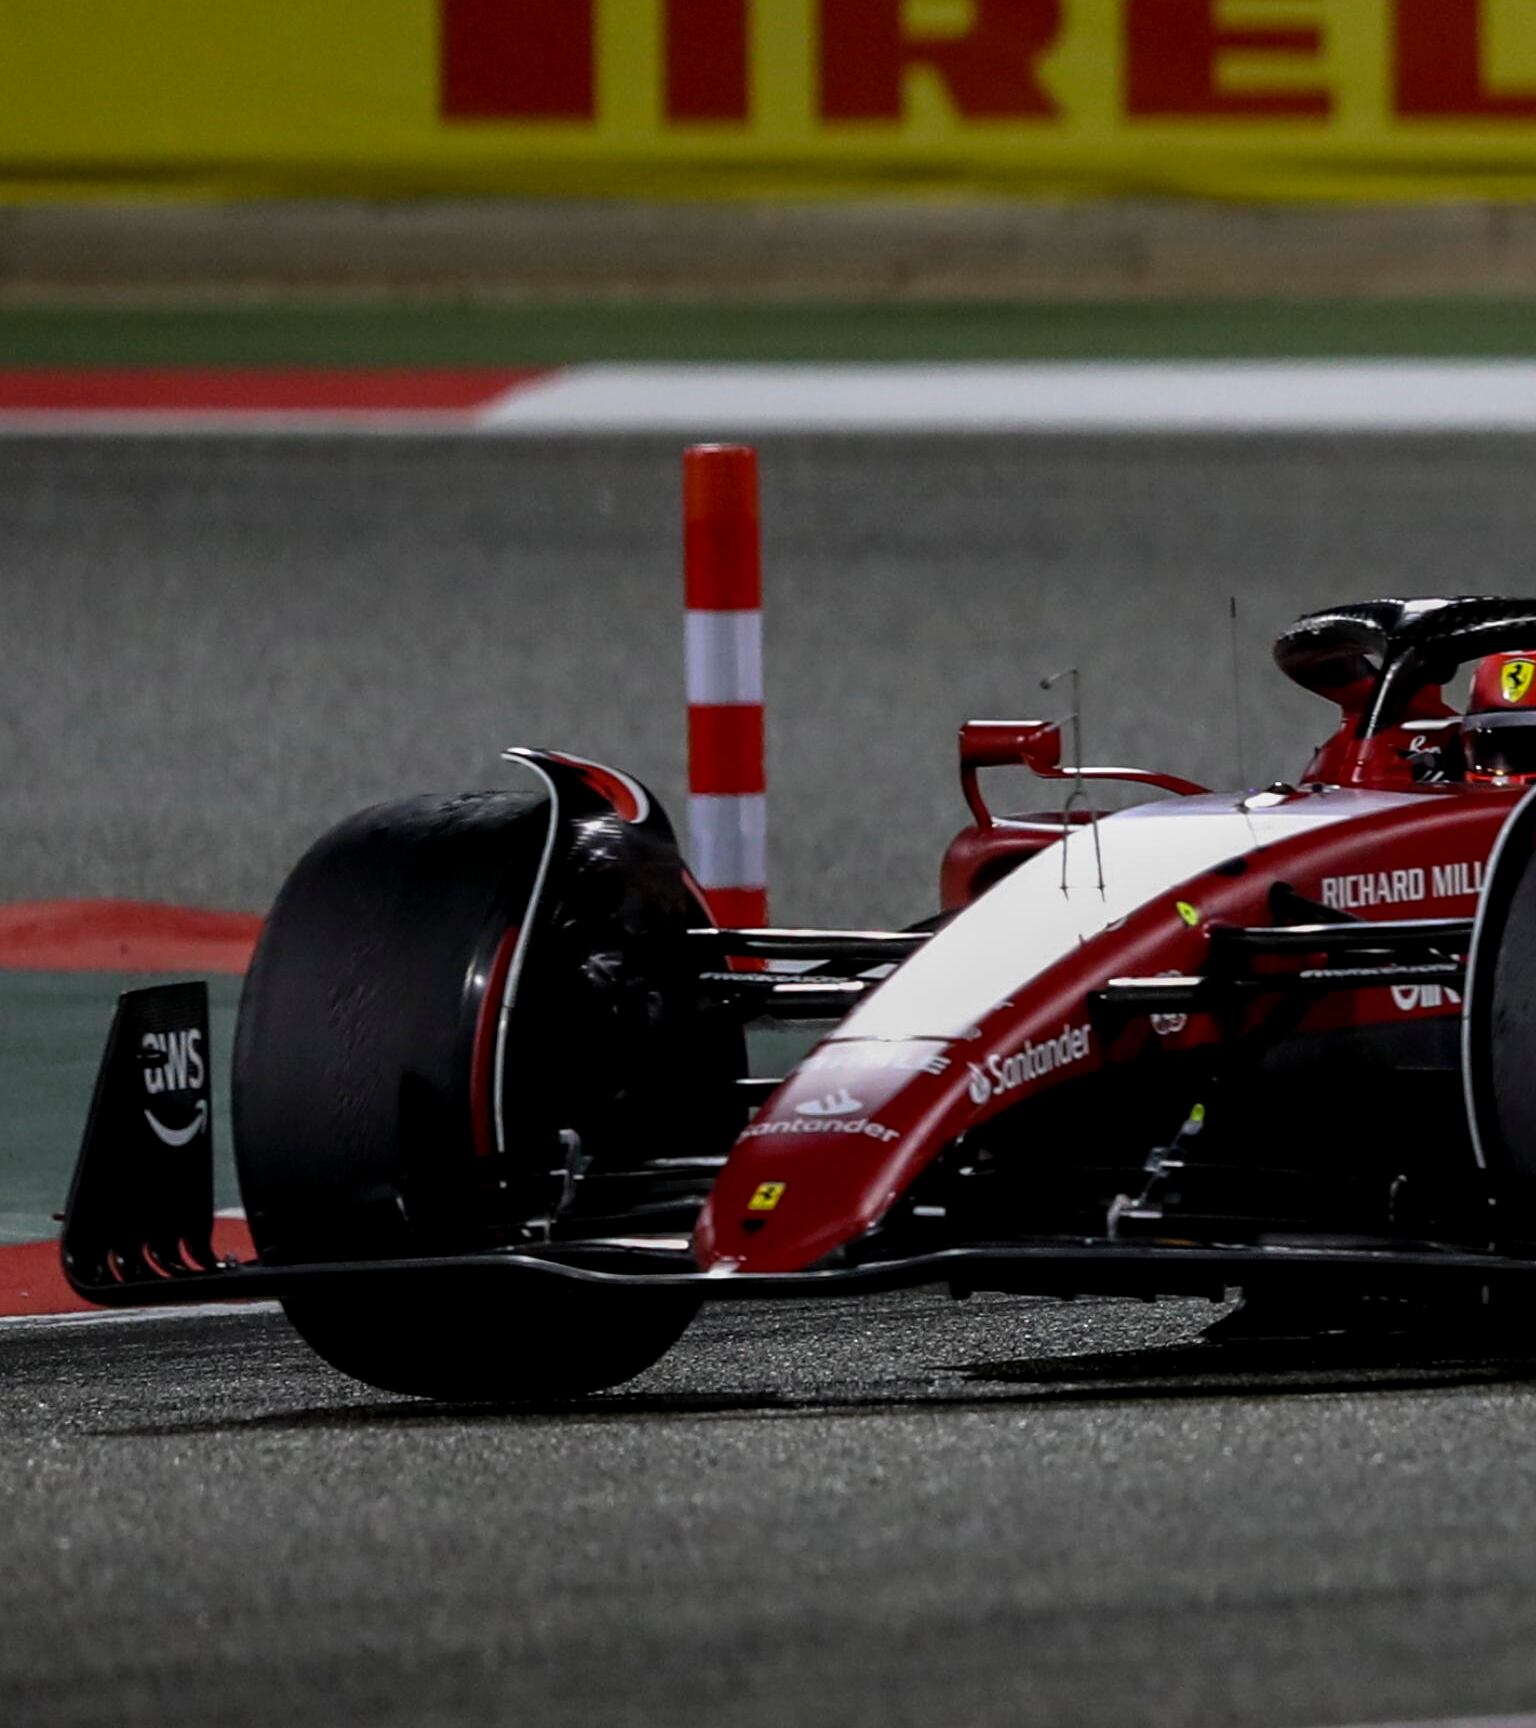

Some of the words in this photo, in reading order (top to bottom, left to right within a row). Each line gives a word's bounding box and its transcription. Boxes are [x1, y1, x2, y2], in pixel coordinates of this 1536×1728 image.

[1322, 867, 1425, 909] RICHARD
[1432, 861, 1486, 898] MILL
[987, 1023, 1092, 1095] Santander
